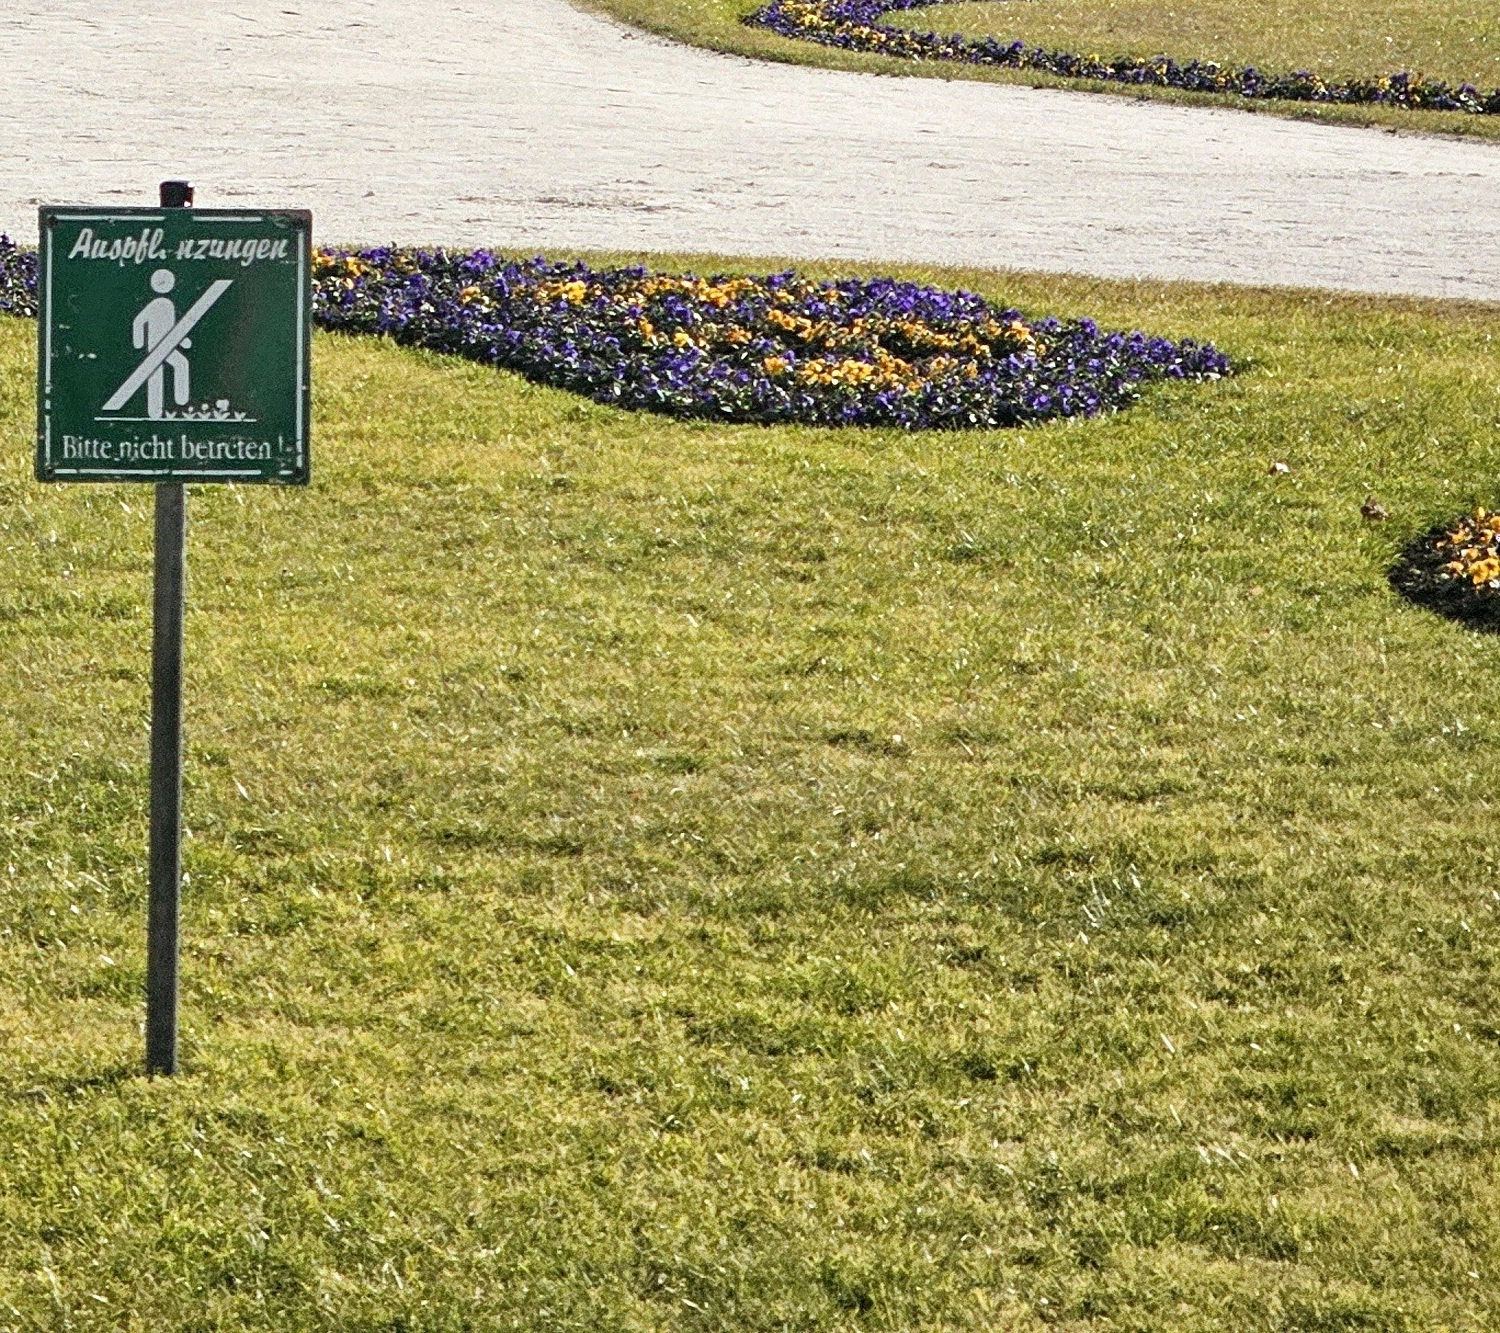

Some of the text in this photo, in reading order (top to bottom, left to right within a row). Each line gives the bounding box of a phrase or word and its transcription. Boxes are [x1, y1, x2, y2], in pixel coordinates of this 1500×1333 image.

[68, 228, 288, 267] Auspflnzungen
[62, 435, 113, 459] Bitte
[119, 434, 175, 460] nicht
[181, 434, 272, 460] betreten
